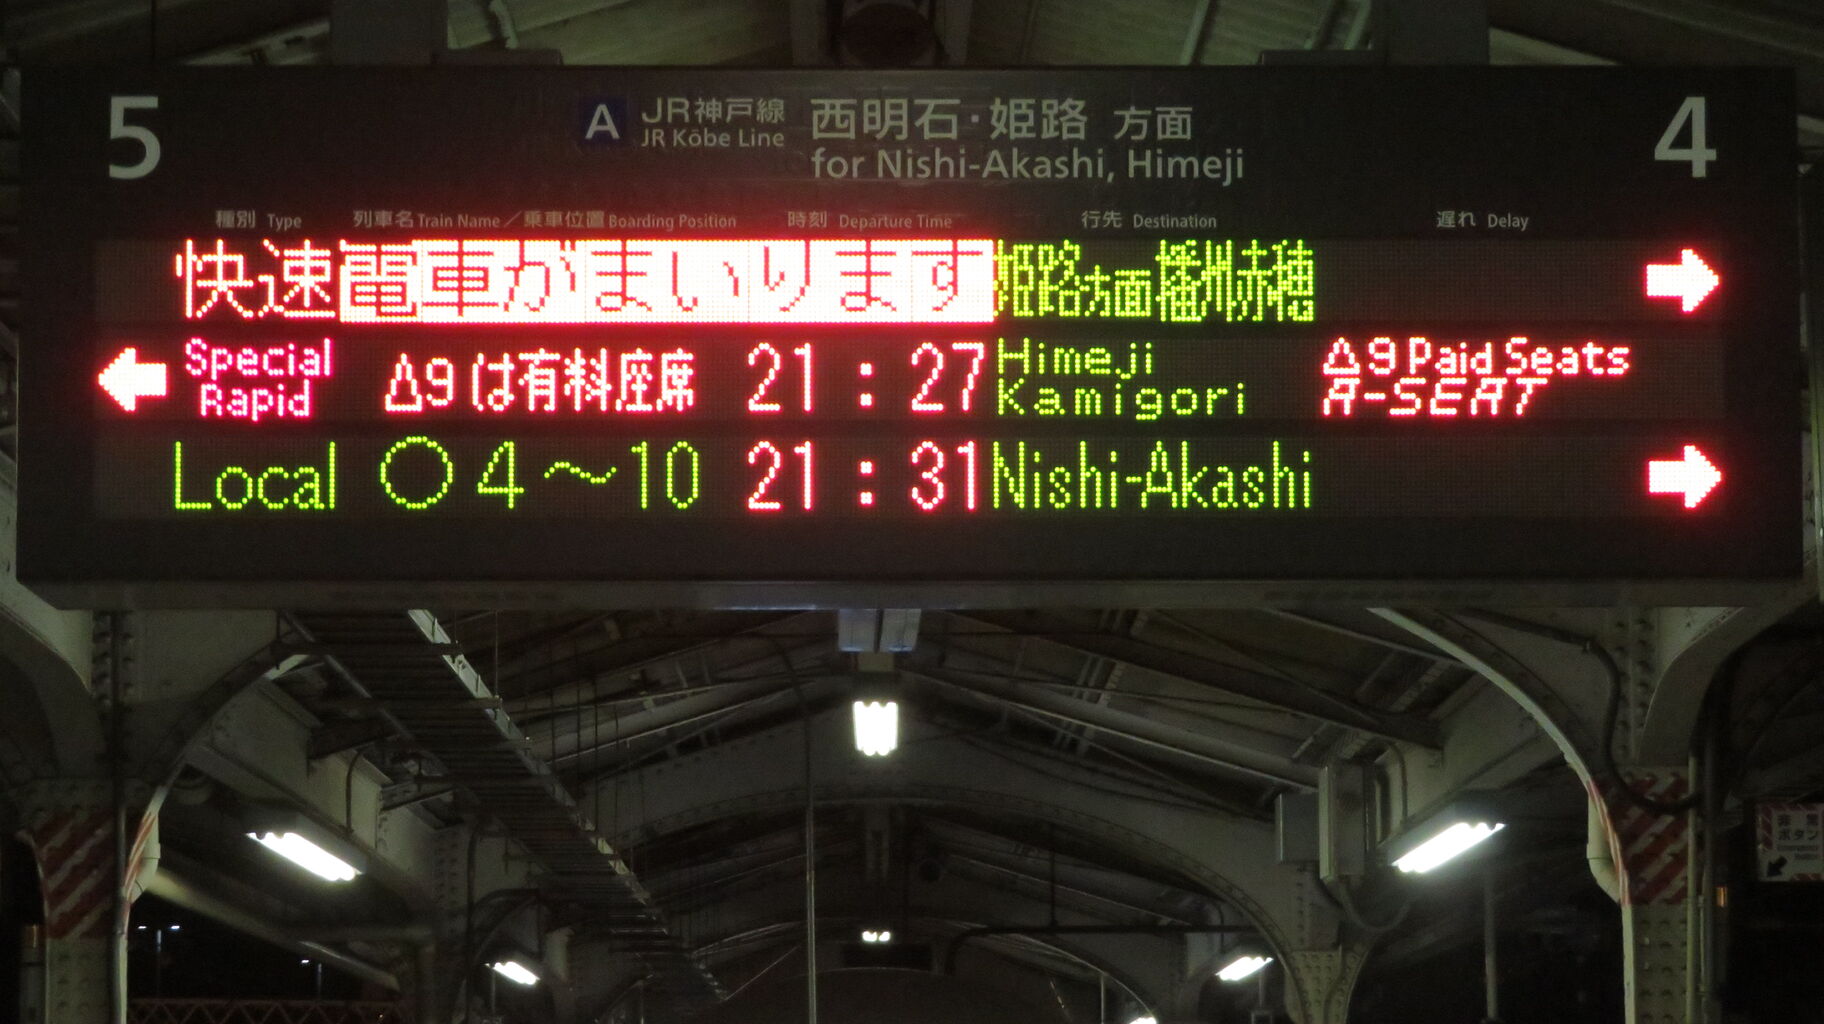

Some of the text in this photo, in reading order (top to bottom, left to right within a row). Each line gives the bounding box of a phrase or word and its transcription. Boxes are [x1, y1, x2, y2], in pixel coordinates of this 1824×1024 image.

[585, 103, 620, 139] A
[641, 97, 785, 123] JR神戸線
[1113, 106, 1193, 140] 方面
[108, 96, 161, 178] 5
[641, 128, 665, 148] JR
[739, 128, 785, 147] Line
[1654, 96, 1717, 178] 4
[811, 147, 1244, 186] for Nishi-Akashi, Himeji
[215, 210, 302, 232] 種別 Type
[353, 210, 414, 228] 列車名
[417, 214, 454, 228] Train
[457, 214, 499, 228] Name
[609, 213, 674, 232] Boarding
[679, 213, 737, 229] Position
[787, 211, 953, 231] 時刻 Departure Time
[1081, 210, 1217, 229] 行先 Destination
[1436, 210, 1529, 231] 遅れ Delay
[185, 338, 332, 380] Special
[997, 337, 1154, 380] Himeji
[1408, 336, 1493, 375] Paid
[1505, 336, 1630, 375] Seats
[199, 379, 312, 421] Rapid
[997, 378, 1246, 421] Kamigori
[1322, 377, 1549, 416] A-SEAT
[174, 441, 337, 510] Local
[993, 440, 1312, 509] Nishi-Akashi
